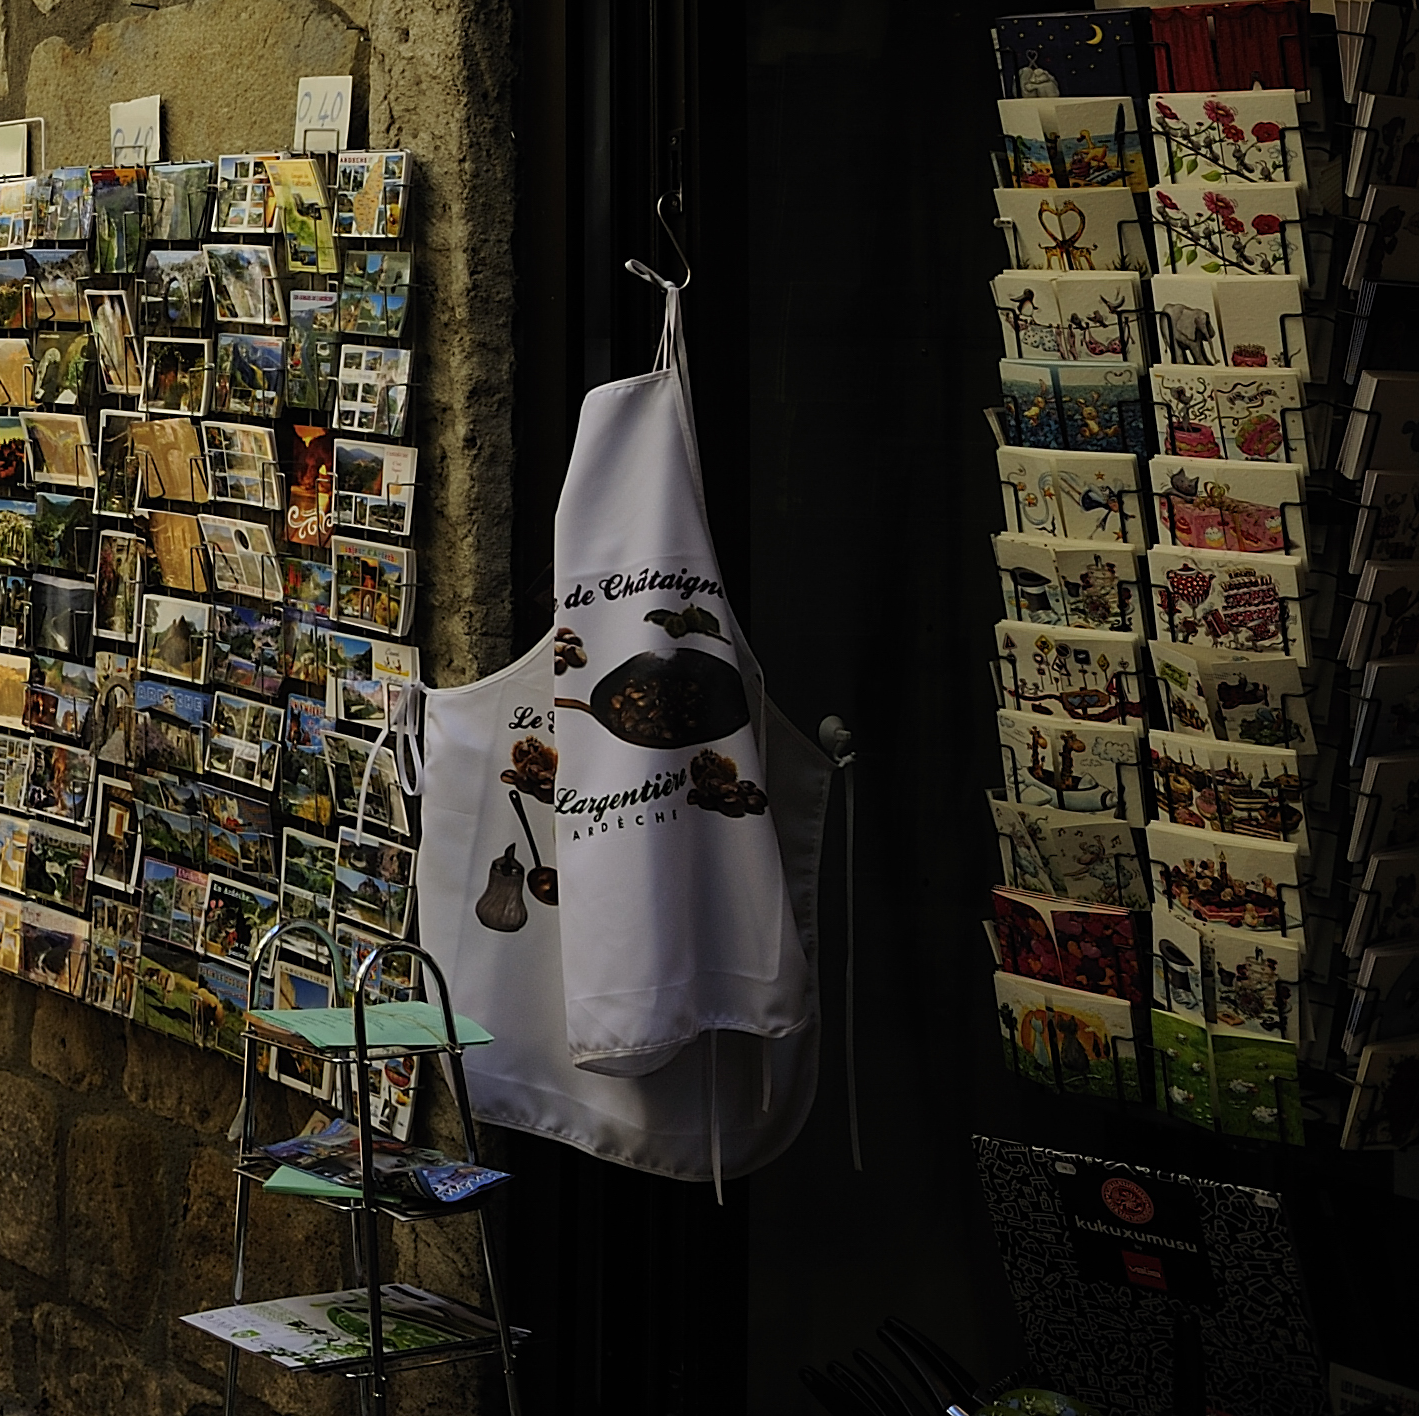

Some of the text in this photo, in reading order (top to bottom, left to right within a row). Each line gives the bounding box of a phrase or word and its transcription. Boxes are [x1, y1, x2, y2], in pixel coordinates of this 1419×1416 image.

[564, 584, 595, 610] de
[138, 685, 202, 712] ARDCHE
[509, 706, 543, 730] Le
[1074, 1214, 1199, 1254] kukuxumusu
